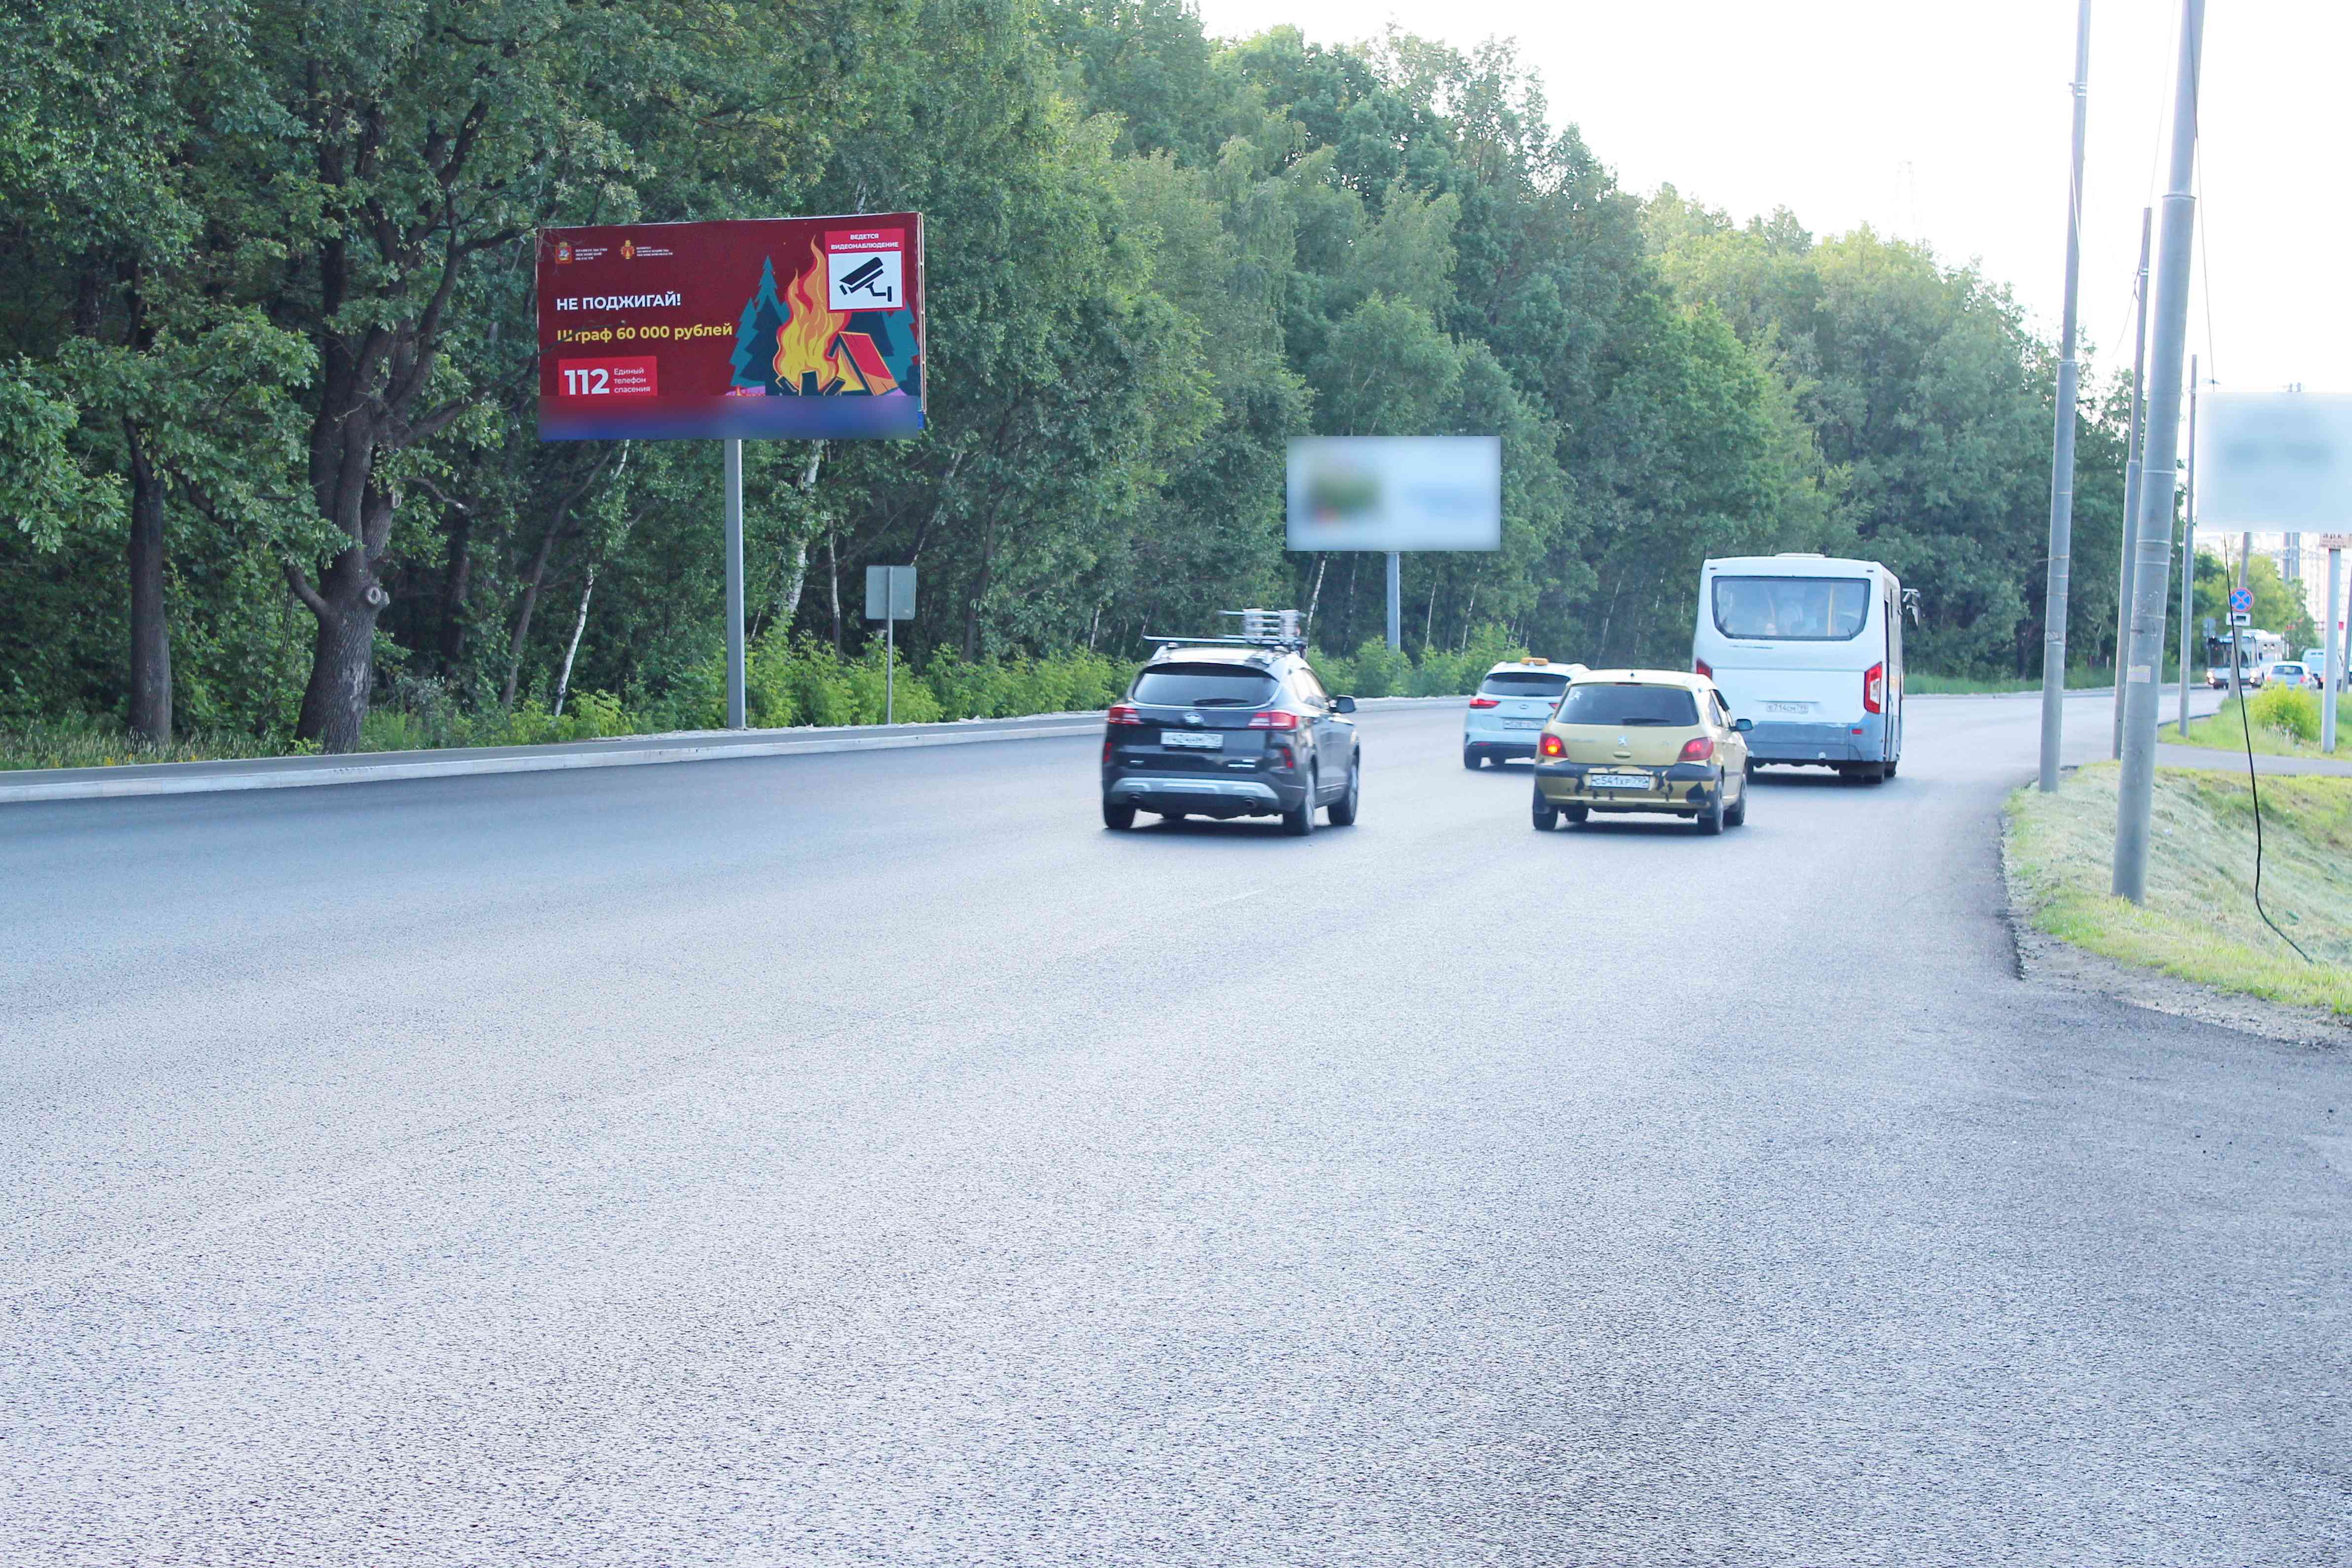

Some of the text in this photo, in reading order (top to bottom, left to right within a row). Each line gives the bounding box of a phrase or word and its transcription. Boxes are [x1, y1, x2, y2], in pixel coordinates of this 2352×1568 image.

[831, 242, 899, 250] ВИДЕОНАБЛЮДЕНИЕ
[556, 291, 681, 311] НЕ ПОДЖИГАЙ!
[557, 323, 733, 344] Штраф 60 000 рублей
[564, 368, 610, 395] 112
